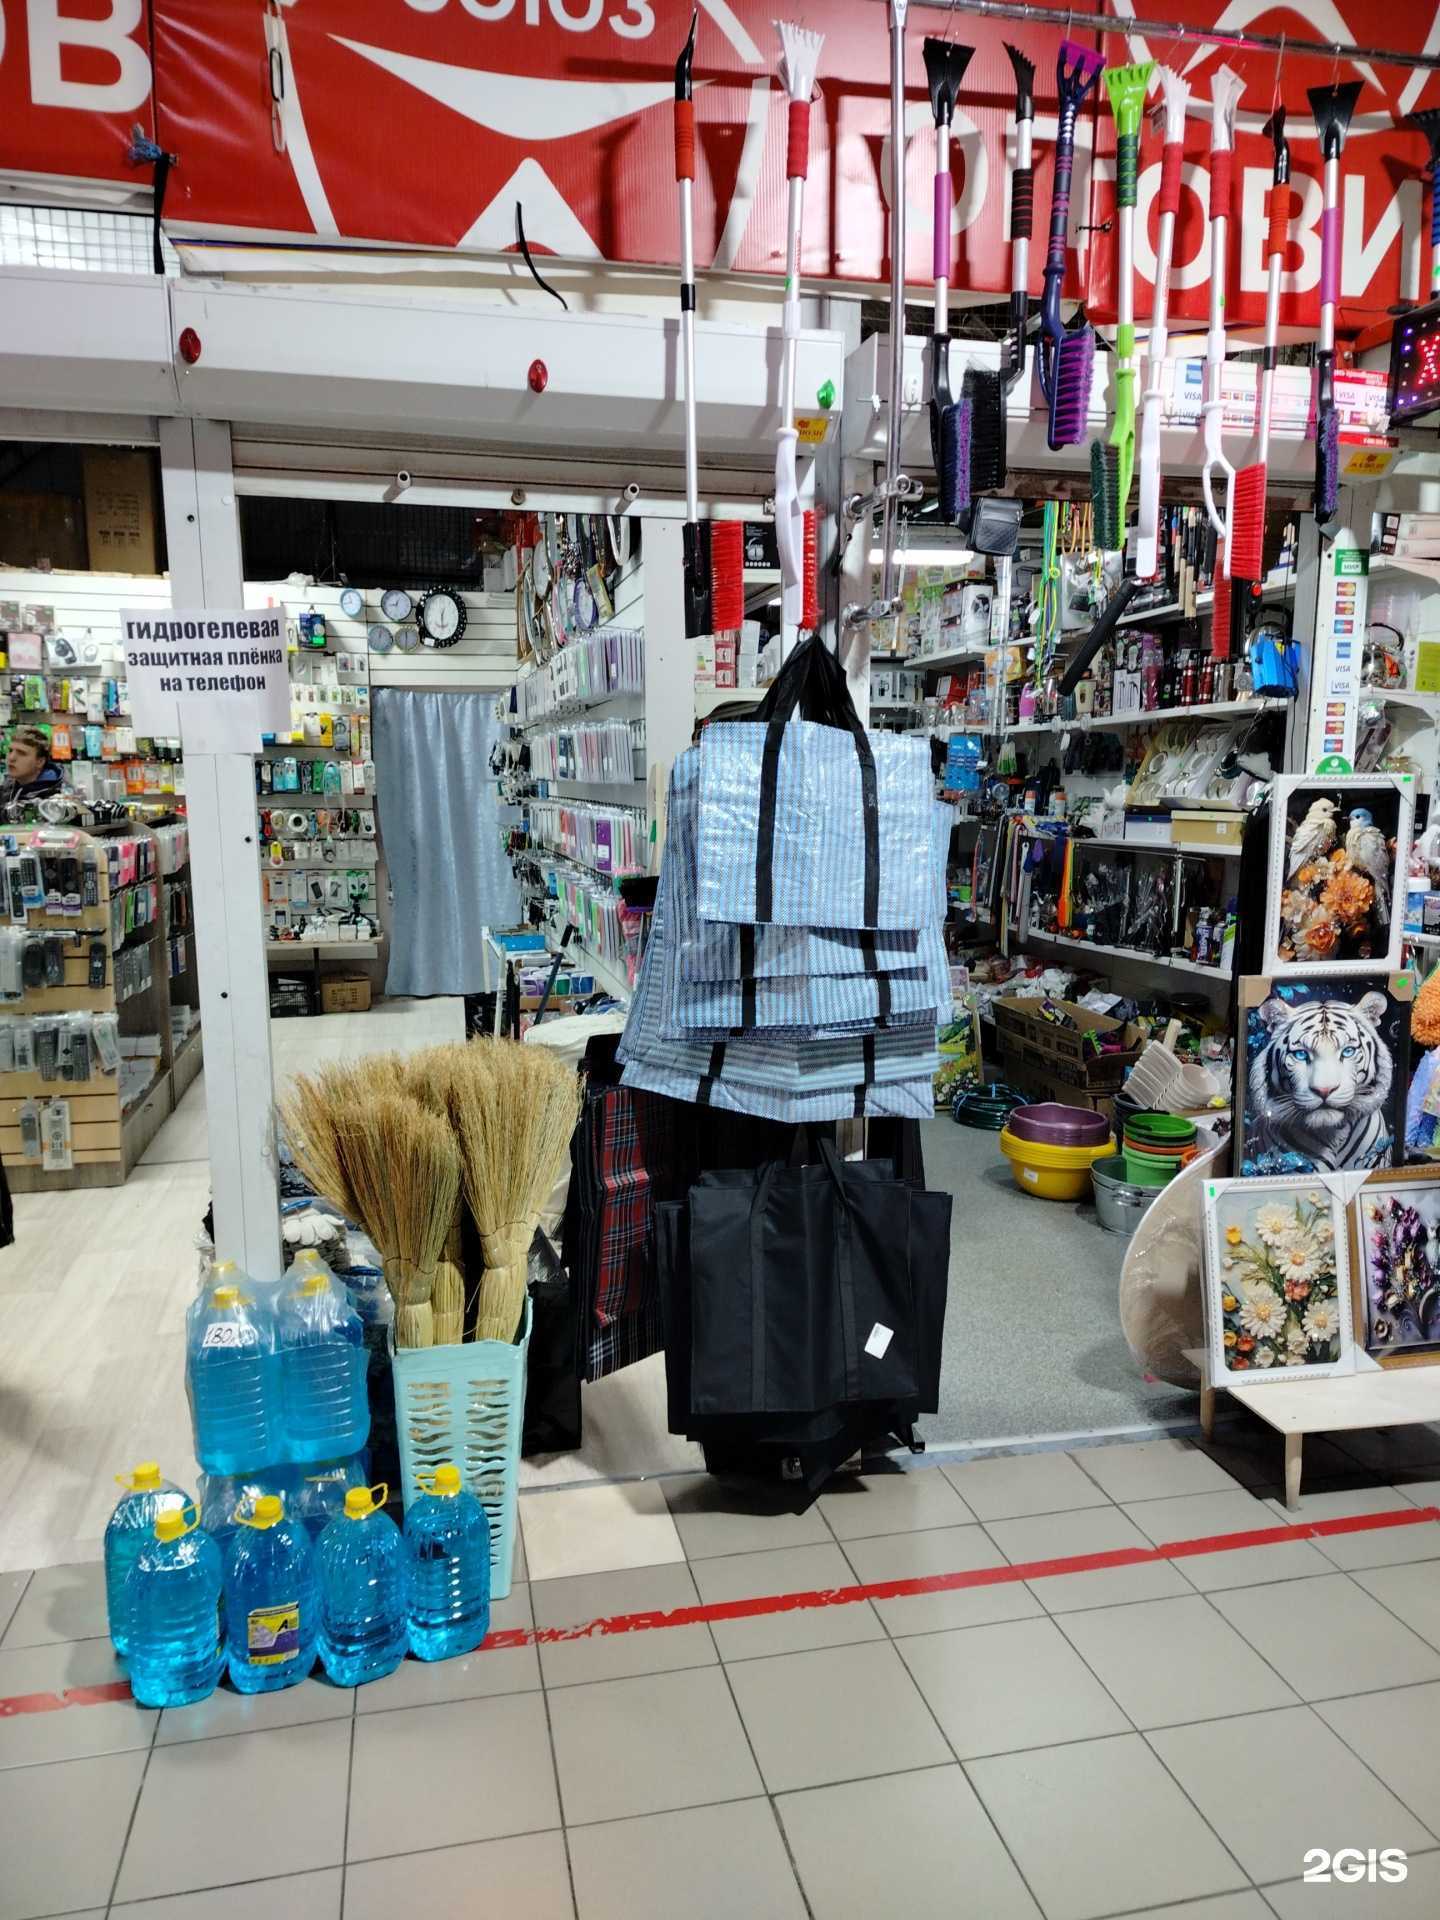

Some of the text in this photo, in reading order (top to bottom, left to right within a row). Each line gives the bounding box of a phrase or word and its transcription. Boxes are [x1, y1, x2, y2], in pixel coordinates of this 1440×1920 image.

[126, 619, 280, 642] гидрогелевая
[128, 647, 283, 668] защитная плёнка
[1335, 665, 1351, 673] VISA
[160, 674, 266, 692] на телефон
